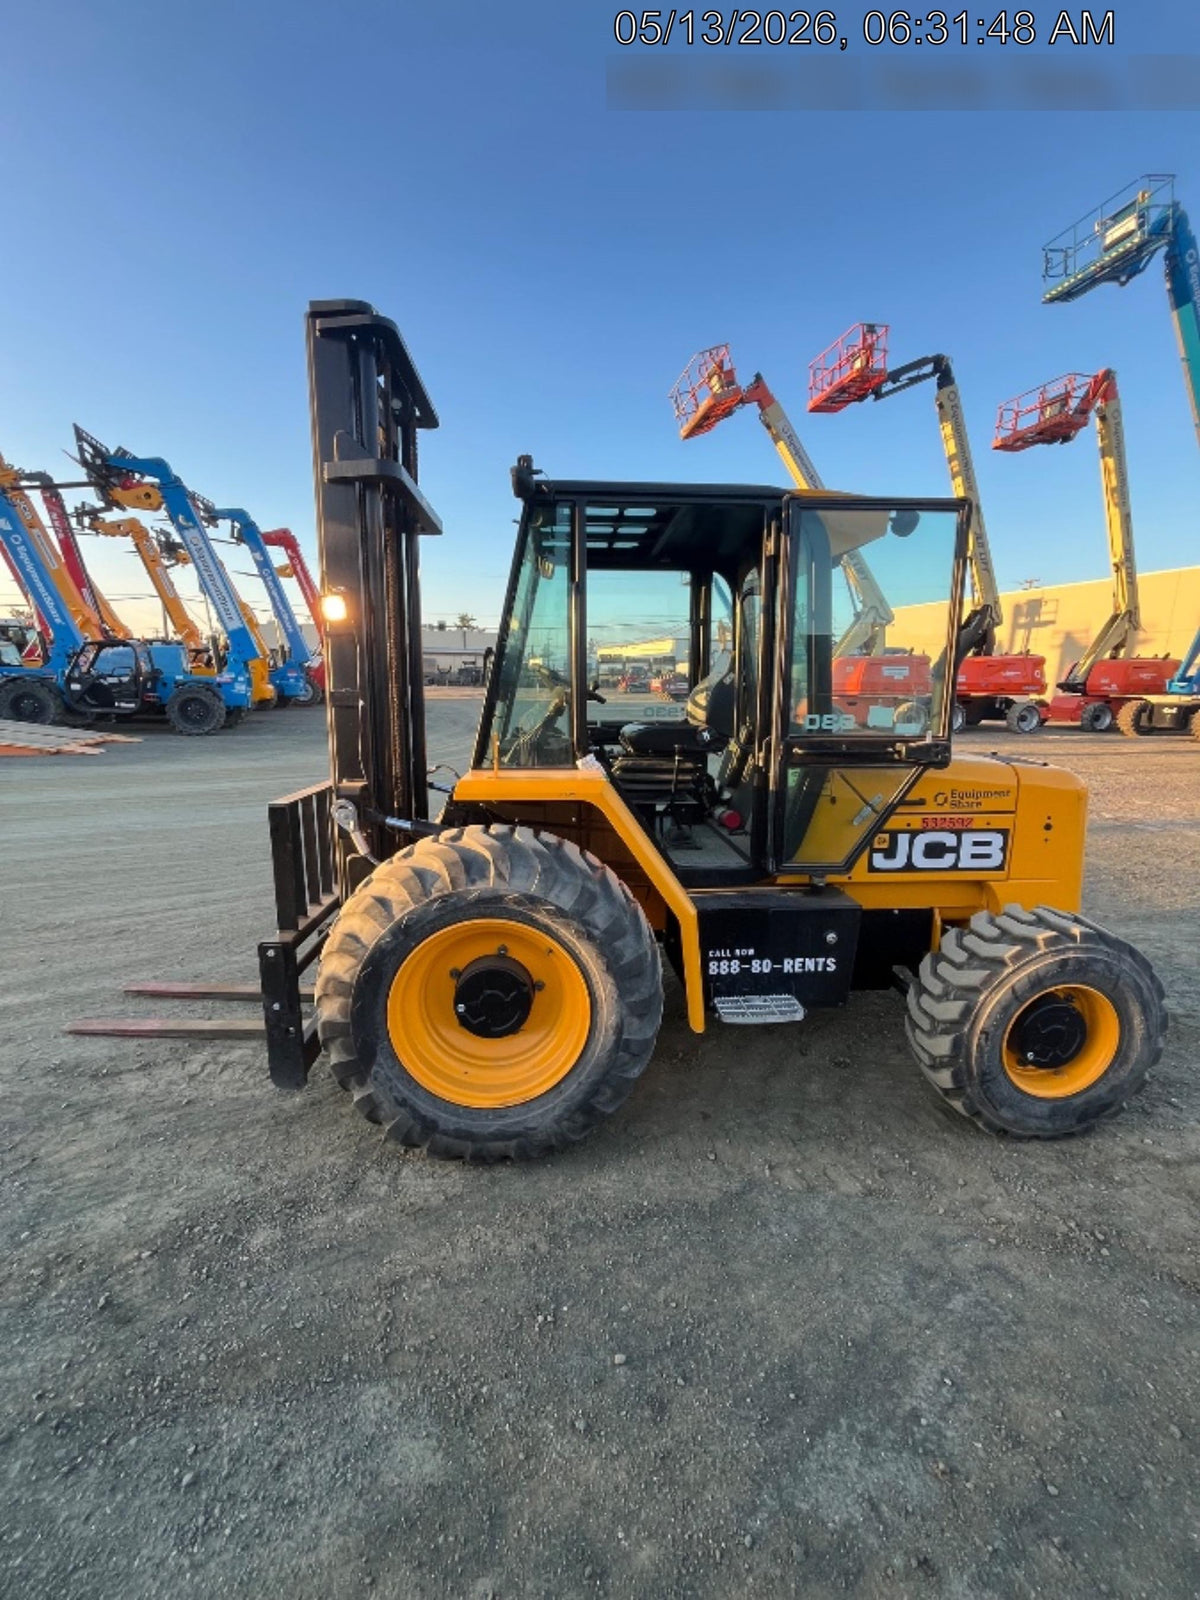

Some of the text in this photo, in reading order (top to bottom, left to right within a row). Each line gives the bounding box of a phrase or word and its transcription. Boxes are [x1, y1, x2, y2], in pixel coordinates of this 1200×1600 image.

[17, 544, 63, 625] EquipmentShare
[951, 789, 1011, 800] Equipment
[950, 800, 982, 809] Share
[872, 832, 1004, 869] JCB
[709, 948, 755, 957] CALL NOW
[708, 957, 837, 976] 888-80-RENTS
